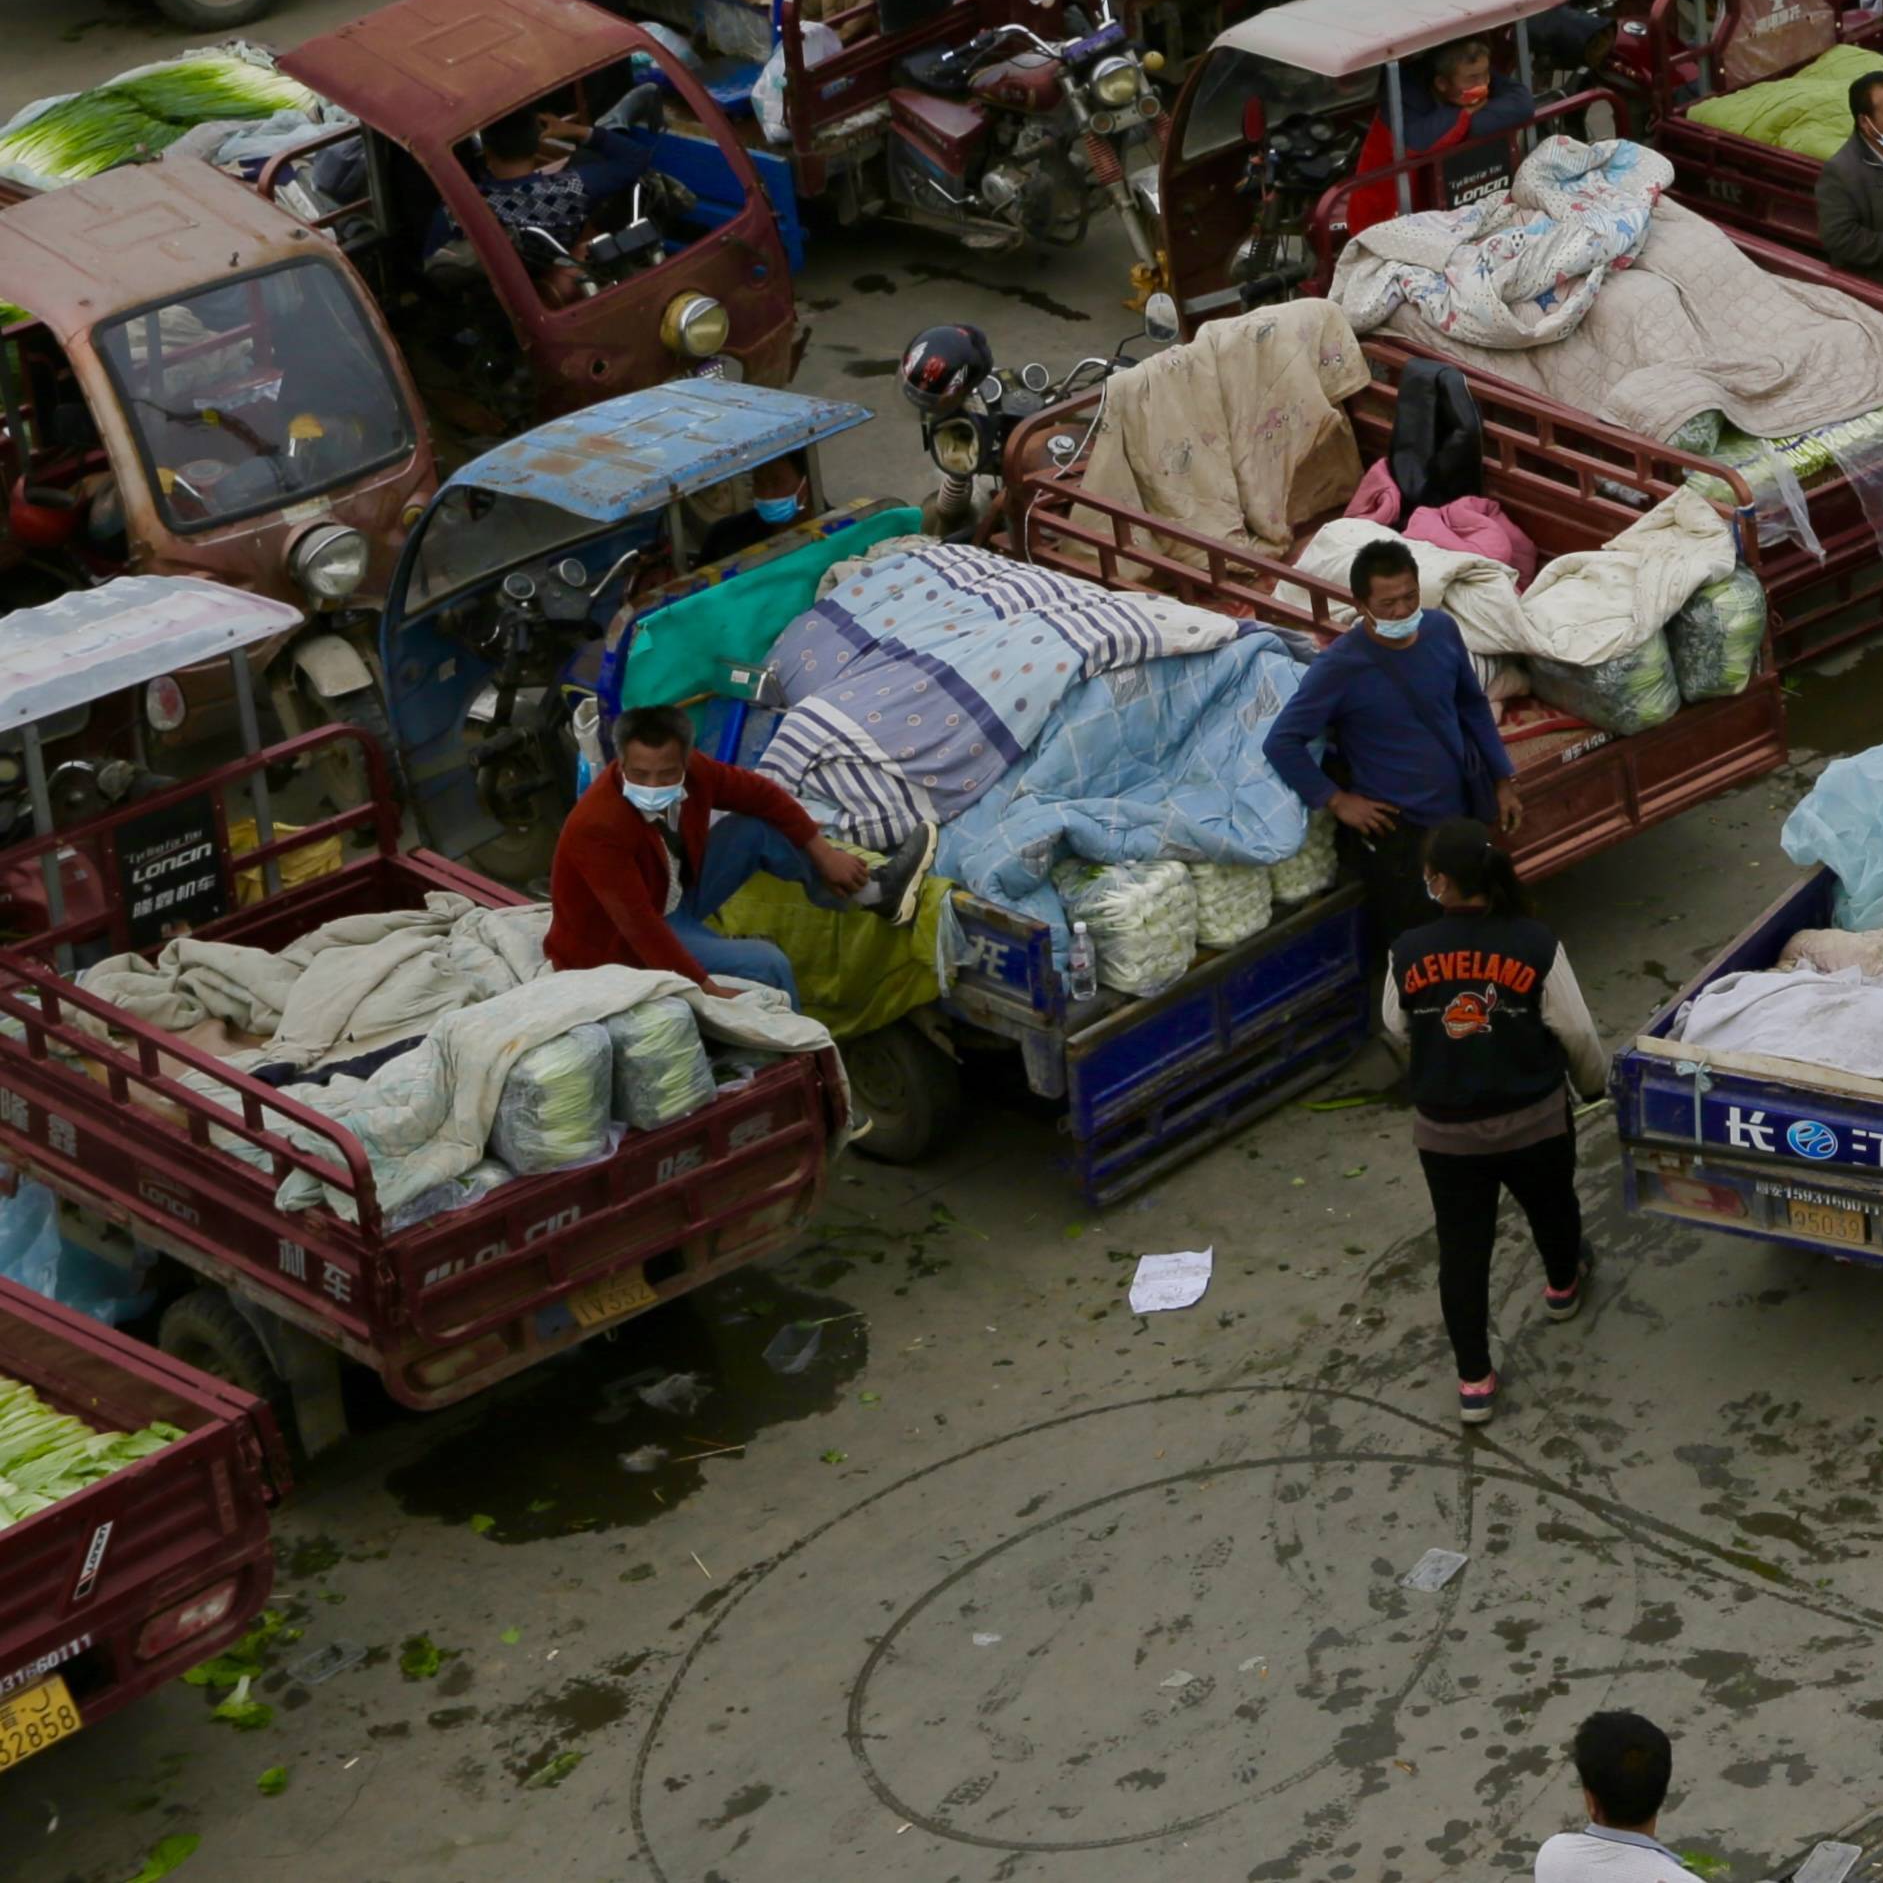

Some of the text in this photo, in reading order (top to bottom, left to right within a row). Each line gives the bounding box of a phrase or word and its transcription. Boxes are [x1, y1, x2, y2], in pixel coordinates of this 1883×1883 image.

[1453, 175, 1510, 207] LONCIN
[132, 842, 212, 884] LONCIN
[1403, 950, 1538, 995] CLEVELAND
[1727, 1105, 1779, 1152] 长
